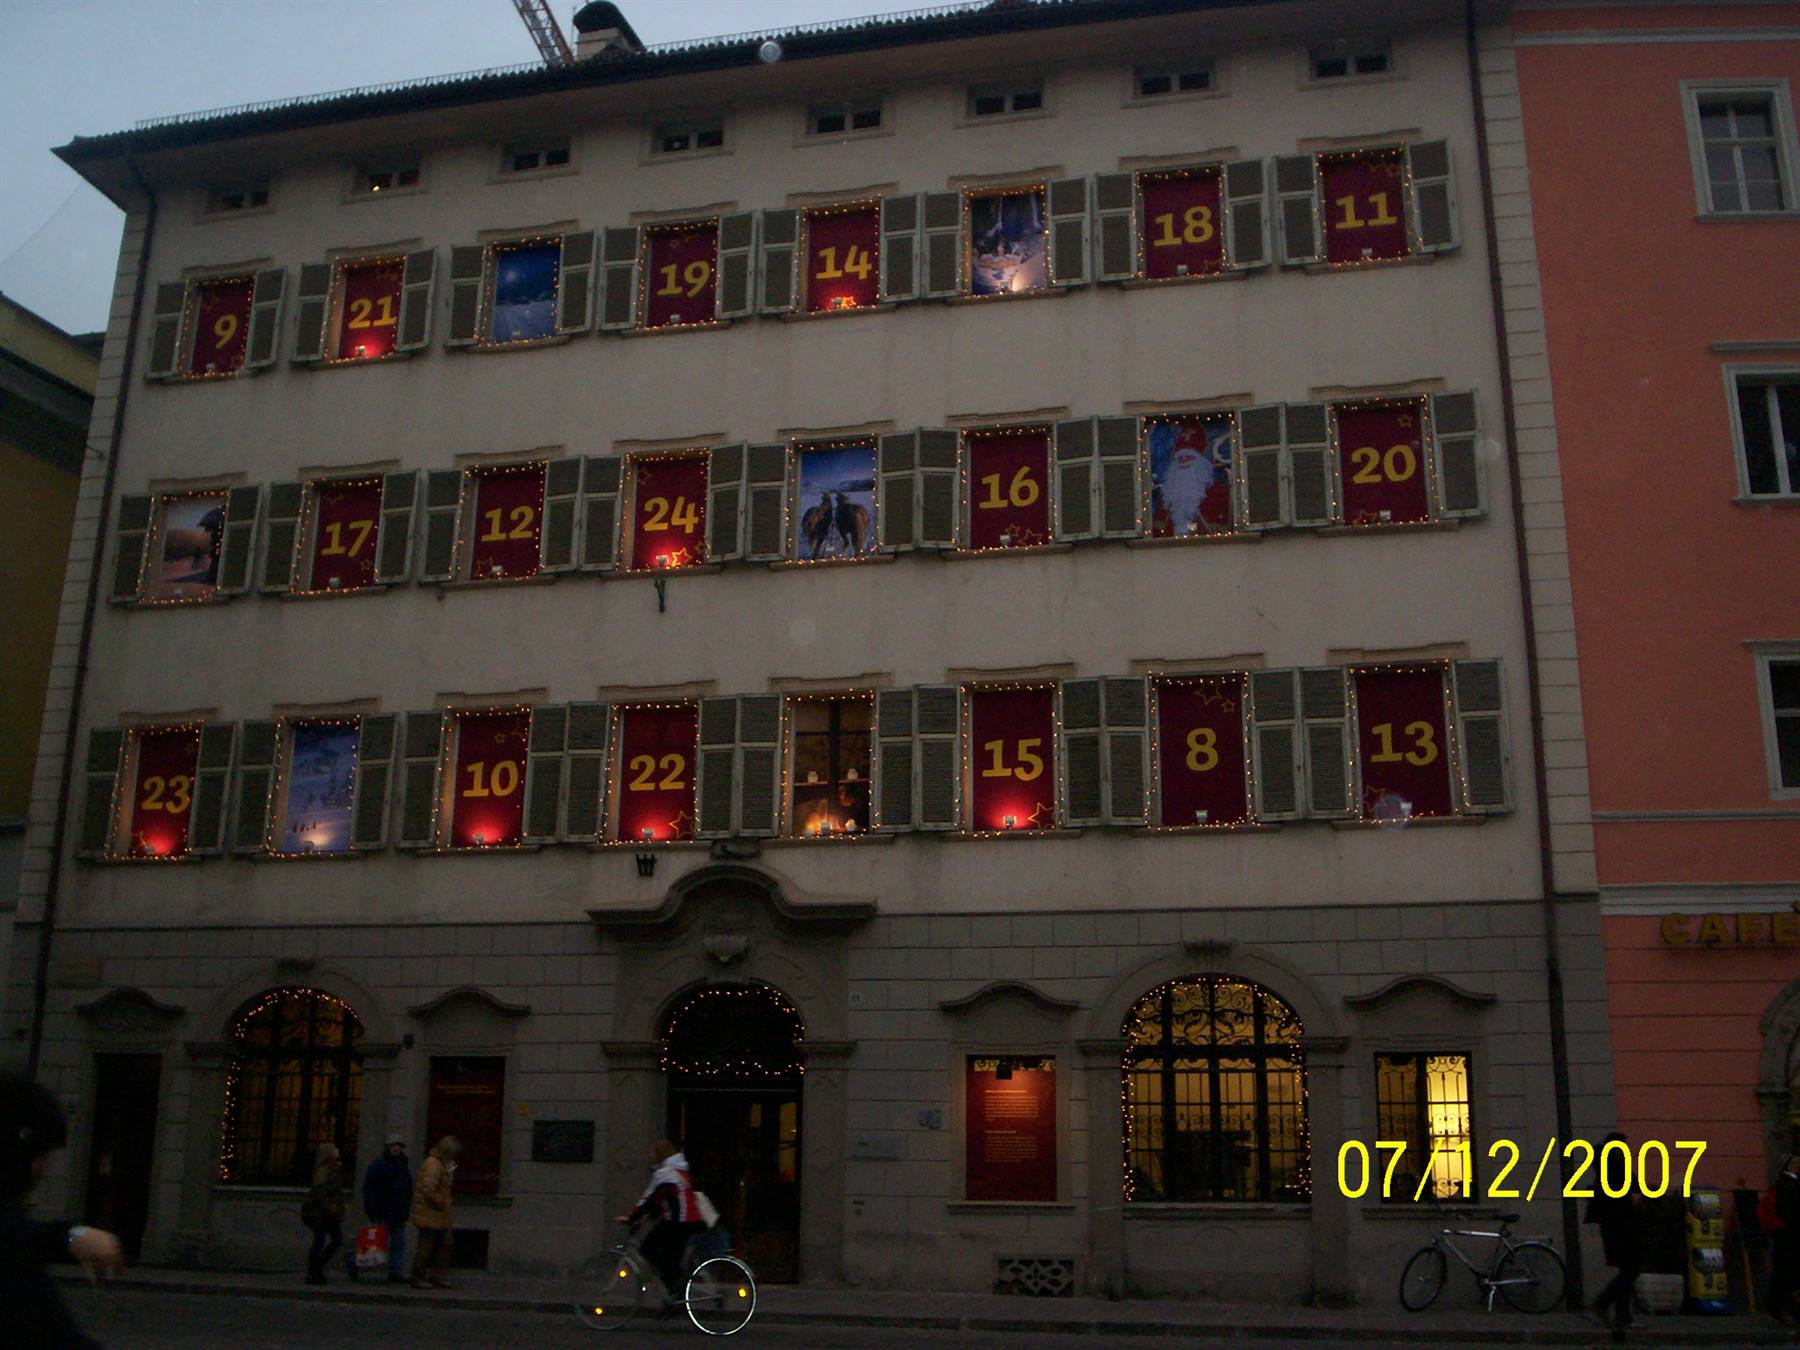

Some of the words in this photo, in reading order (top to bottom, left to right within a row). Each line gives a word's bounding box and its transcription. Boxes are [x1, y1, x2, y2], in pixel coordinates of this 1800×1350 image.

[1154, 207, 1213, 247] 18
[1337, 192, 1397, 229] 11
[659, 262, 711, 297] 19
[815, 245, 871, 281] 14
[348, 296, 396, 329] 21
[214, 315, 239, 351] 9
[1351, 445, 1417, 485] 20
[980, 465, 1040, 510] 16
[482, 506, 535, 542] 12
[643, 495, 700, 534] 24
[322, 520, 373, 558] 17
[981, 737, 1044, 781] 15
[1186, 726, 1218, 772] 8
[1371, 720, 1438, 768] 13
[463, 760, 519, 800] 10
[629, 752, 687, 793] 22
[142, 774, 191, 814] 23
